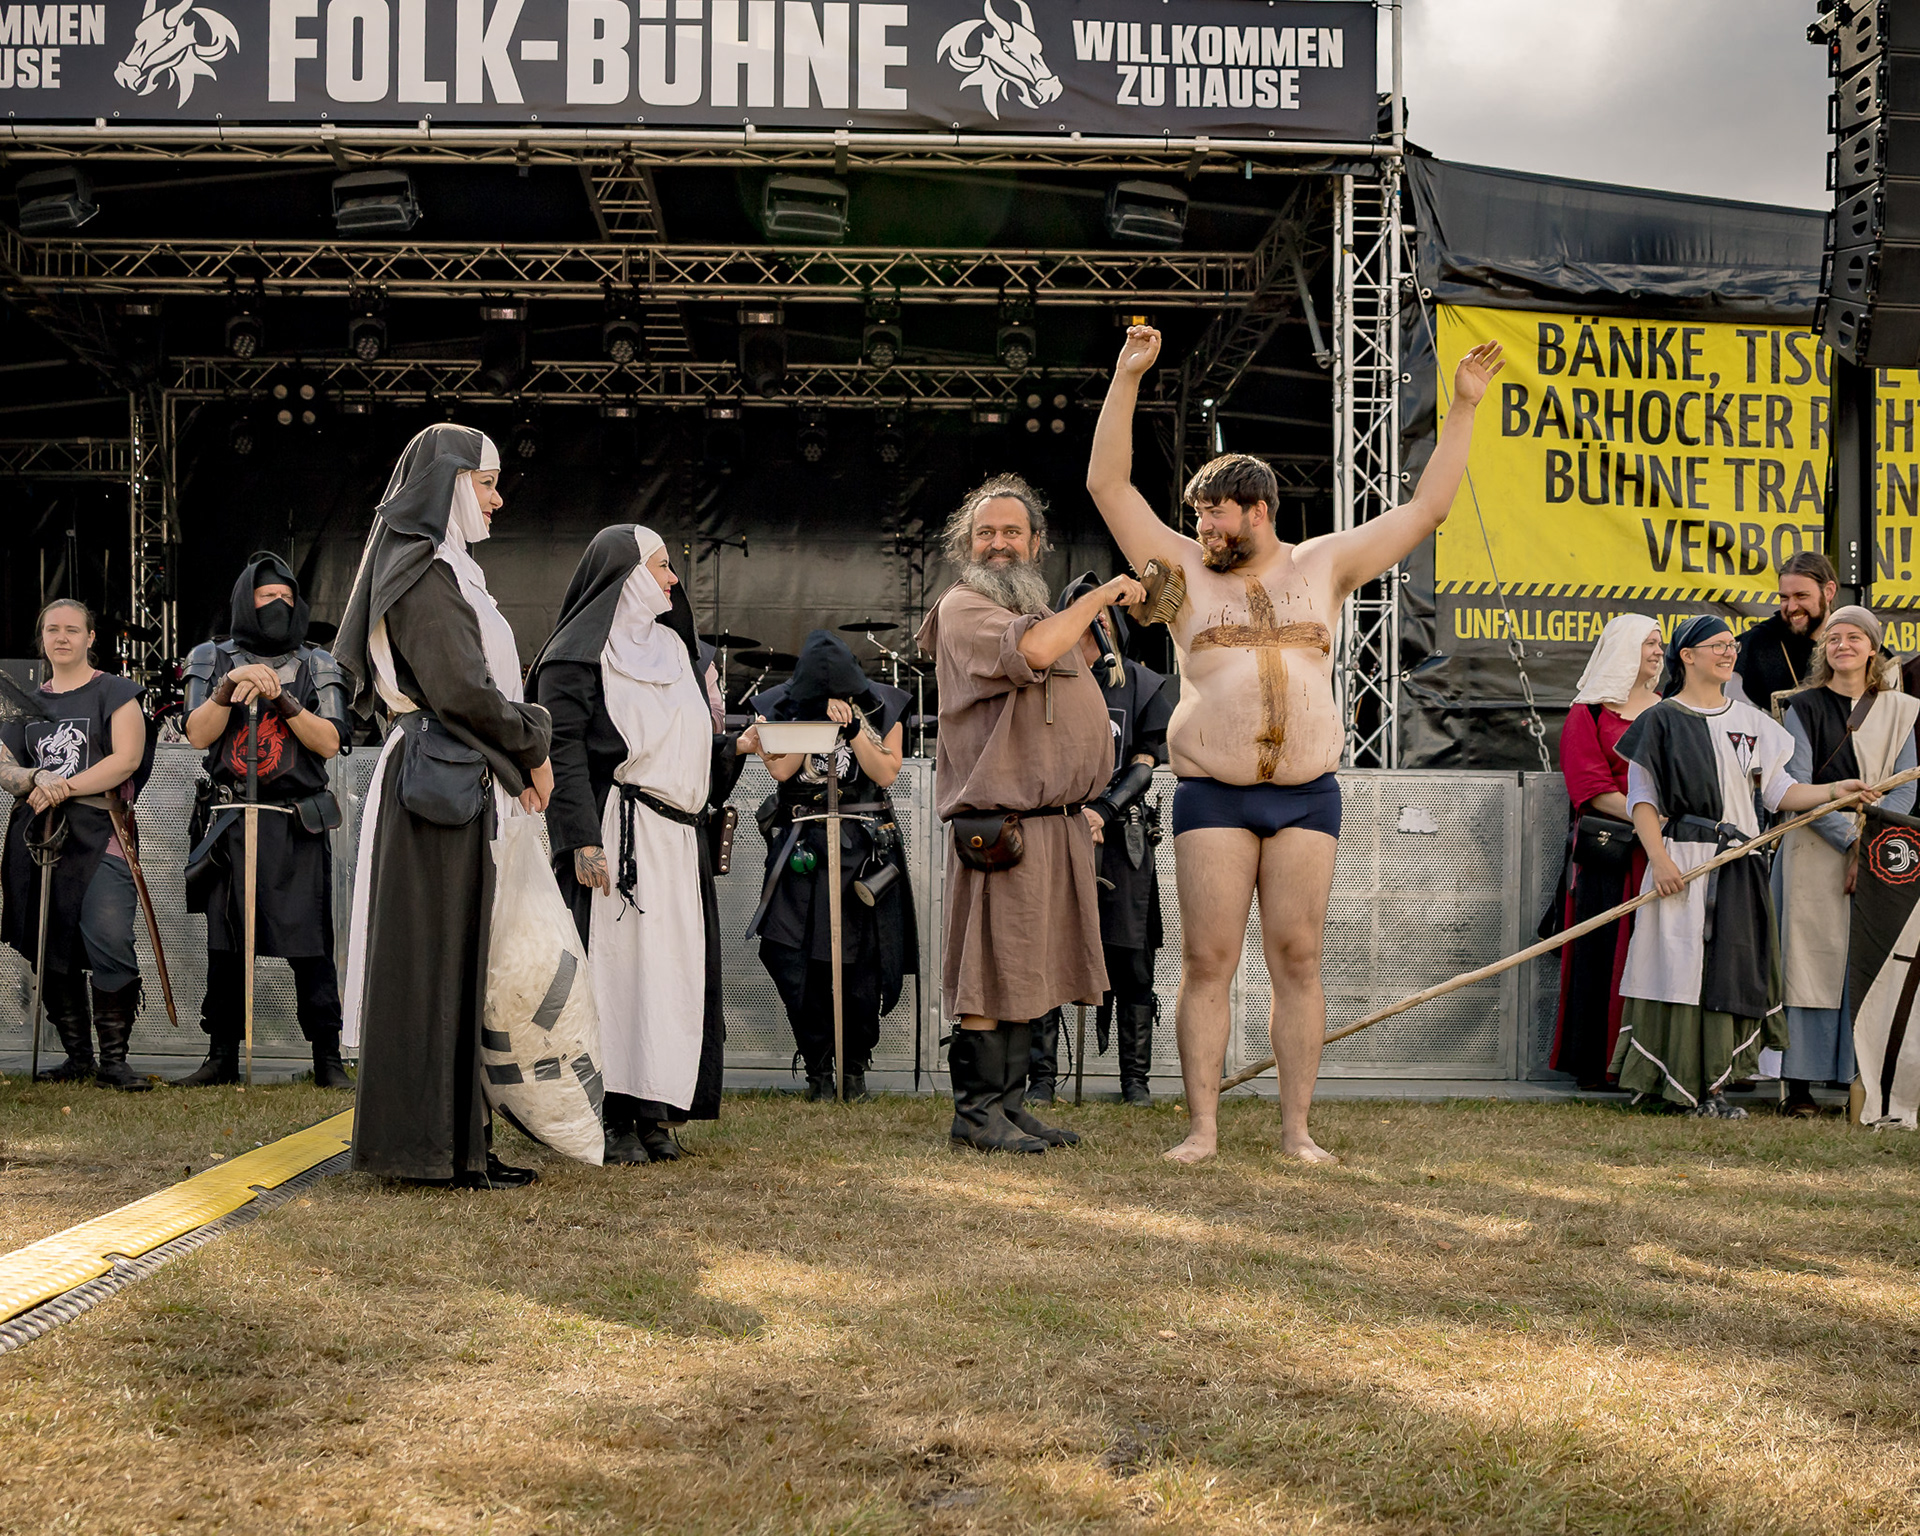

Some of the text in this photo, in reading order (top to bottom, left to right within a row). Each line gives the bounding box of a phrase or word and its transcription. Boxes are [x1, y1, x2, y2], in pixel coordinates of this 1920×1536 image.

[267, 0, 908, 110] FOLK-BÜHNE
[1072, 20, 1344, 68] WILLKOMMEN
[1116, 65, 1300, 109] ZU HAUSE
[1538, 316, 1720, 388] BÄNKE,
[1502, 382, 1794, 449] BARHOCKER
[1545, 442, 1710, 510] BÜHNE
[1455, 608, 1637, 642] UNFALLGEFA
